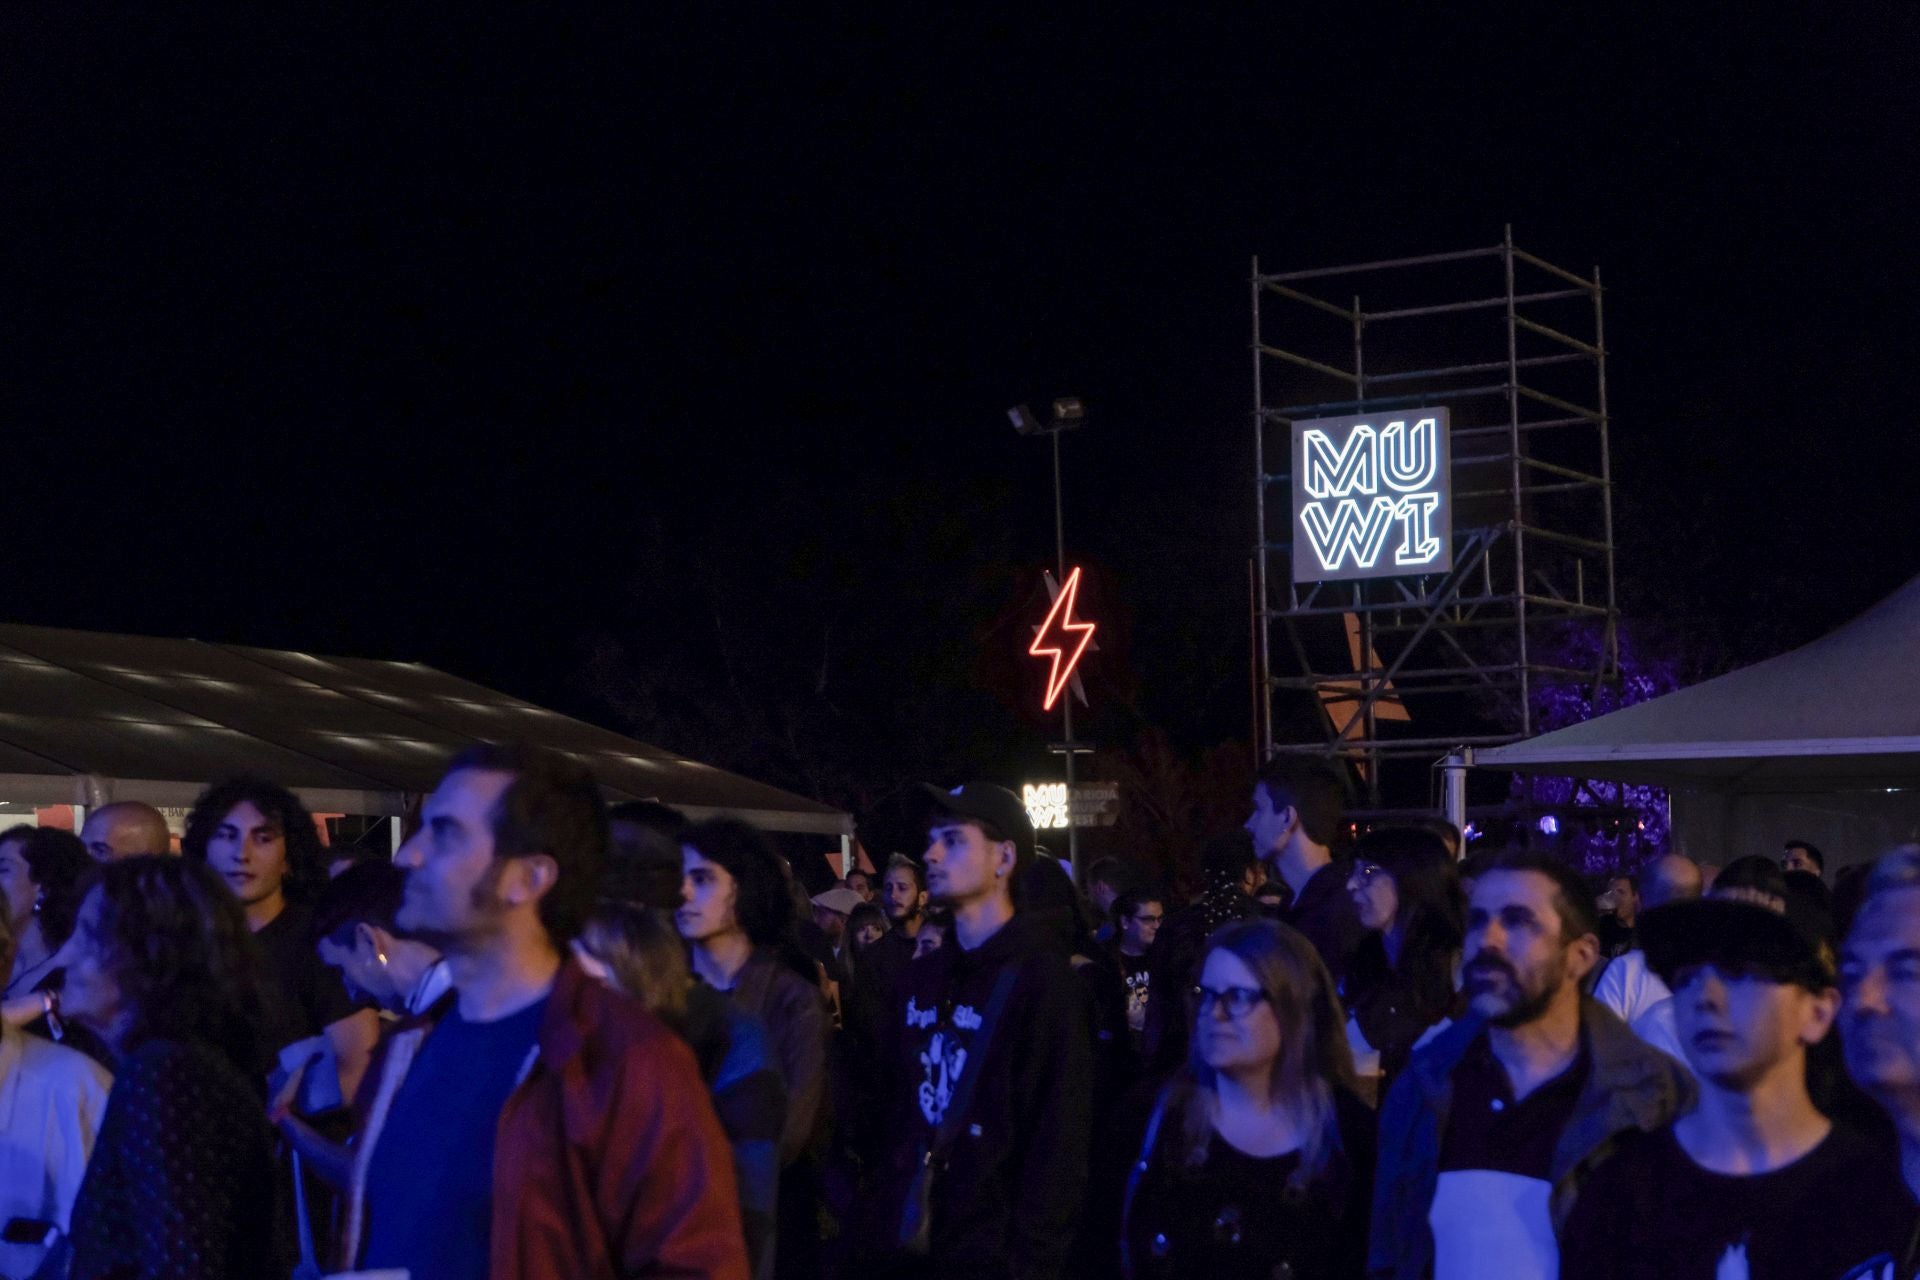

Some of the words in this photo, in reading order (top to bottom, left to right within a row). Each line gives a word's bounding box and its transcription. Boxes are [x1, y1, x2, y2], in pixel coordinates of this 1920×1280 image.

[1303, 419, 1436, 498] MU
[1300, 491, 1439, 569] WI
[1023, 783, 1066, 807] MU
